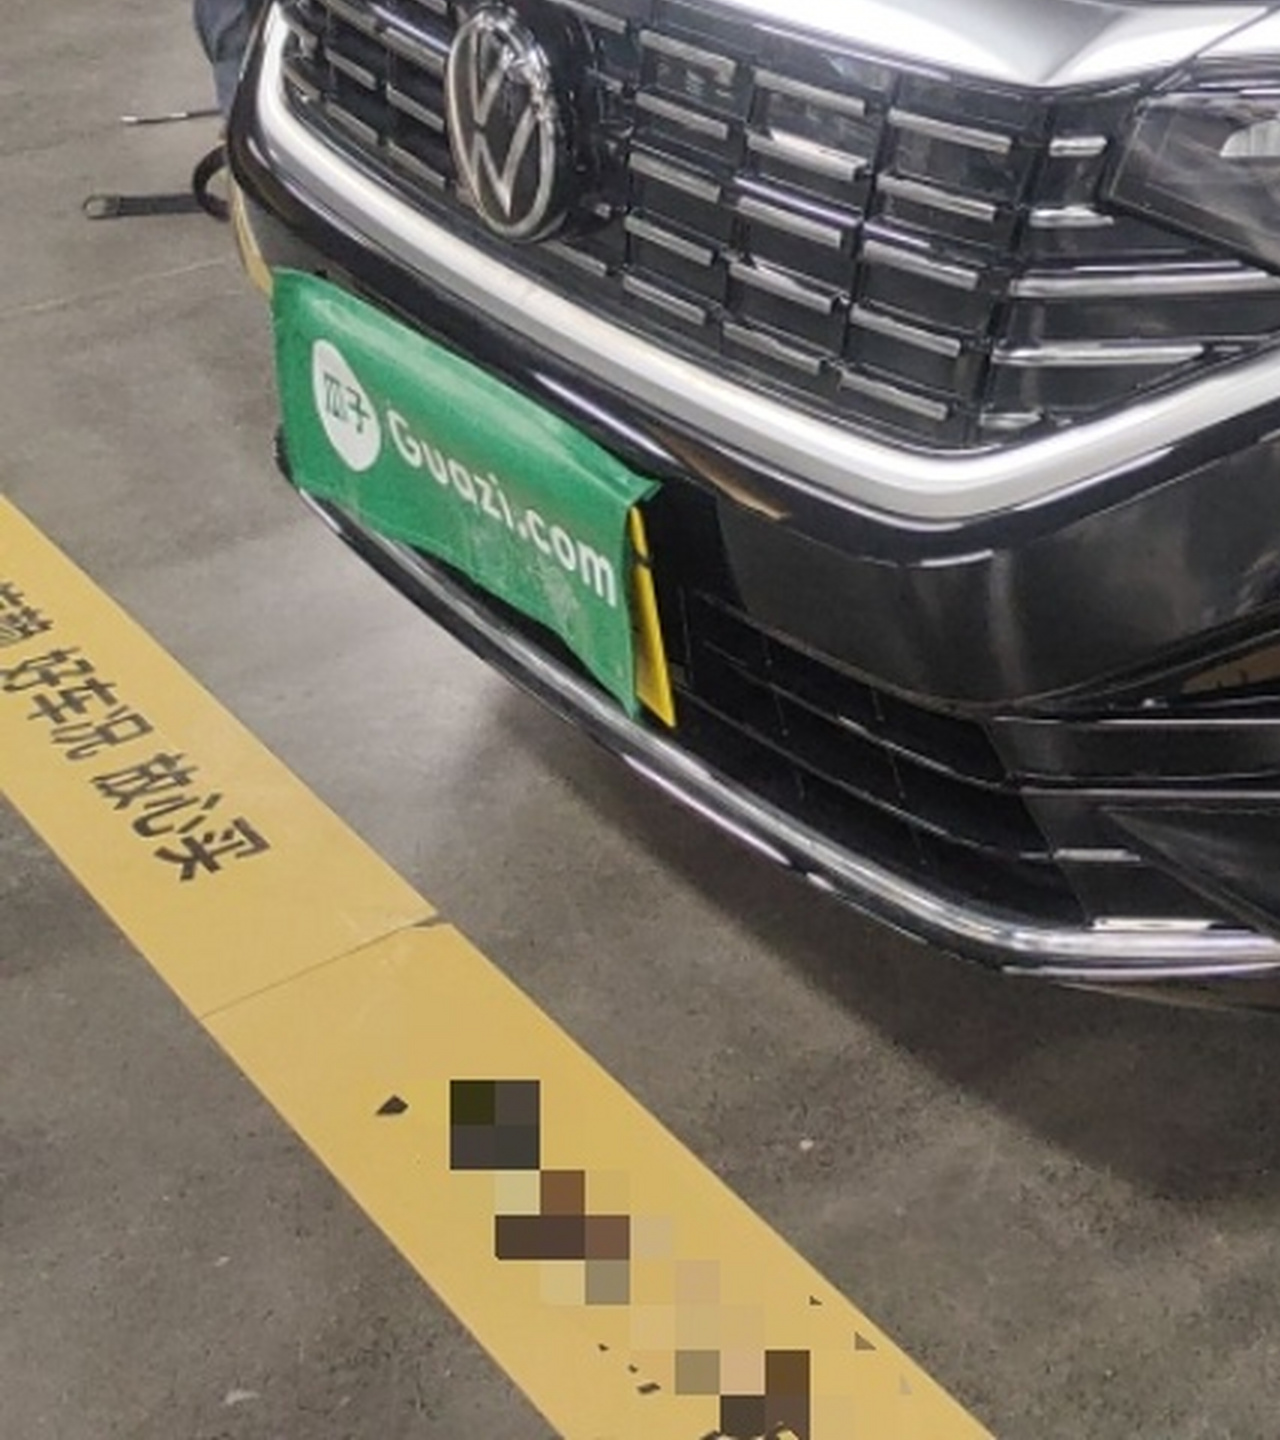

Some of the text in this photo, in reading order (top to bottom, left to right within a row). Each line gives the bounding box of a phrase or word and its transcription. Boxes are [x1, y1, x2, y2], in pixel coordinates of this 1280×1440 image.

[387, 408, 617, 608] Guazi.com
[0, 646, 272, 883] 好车况 放心买
